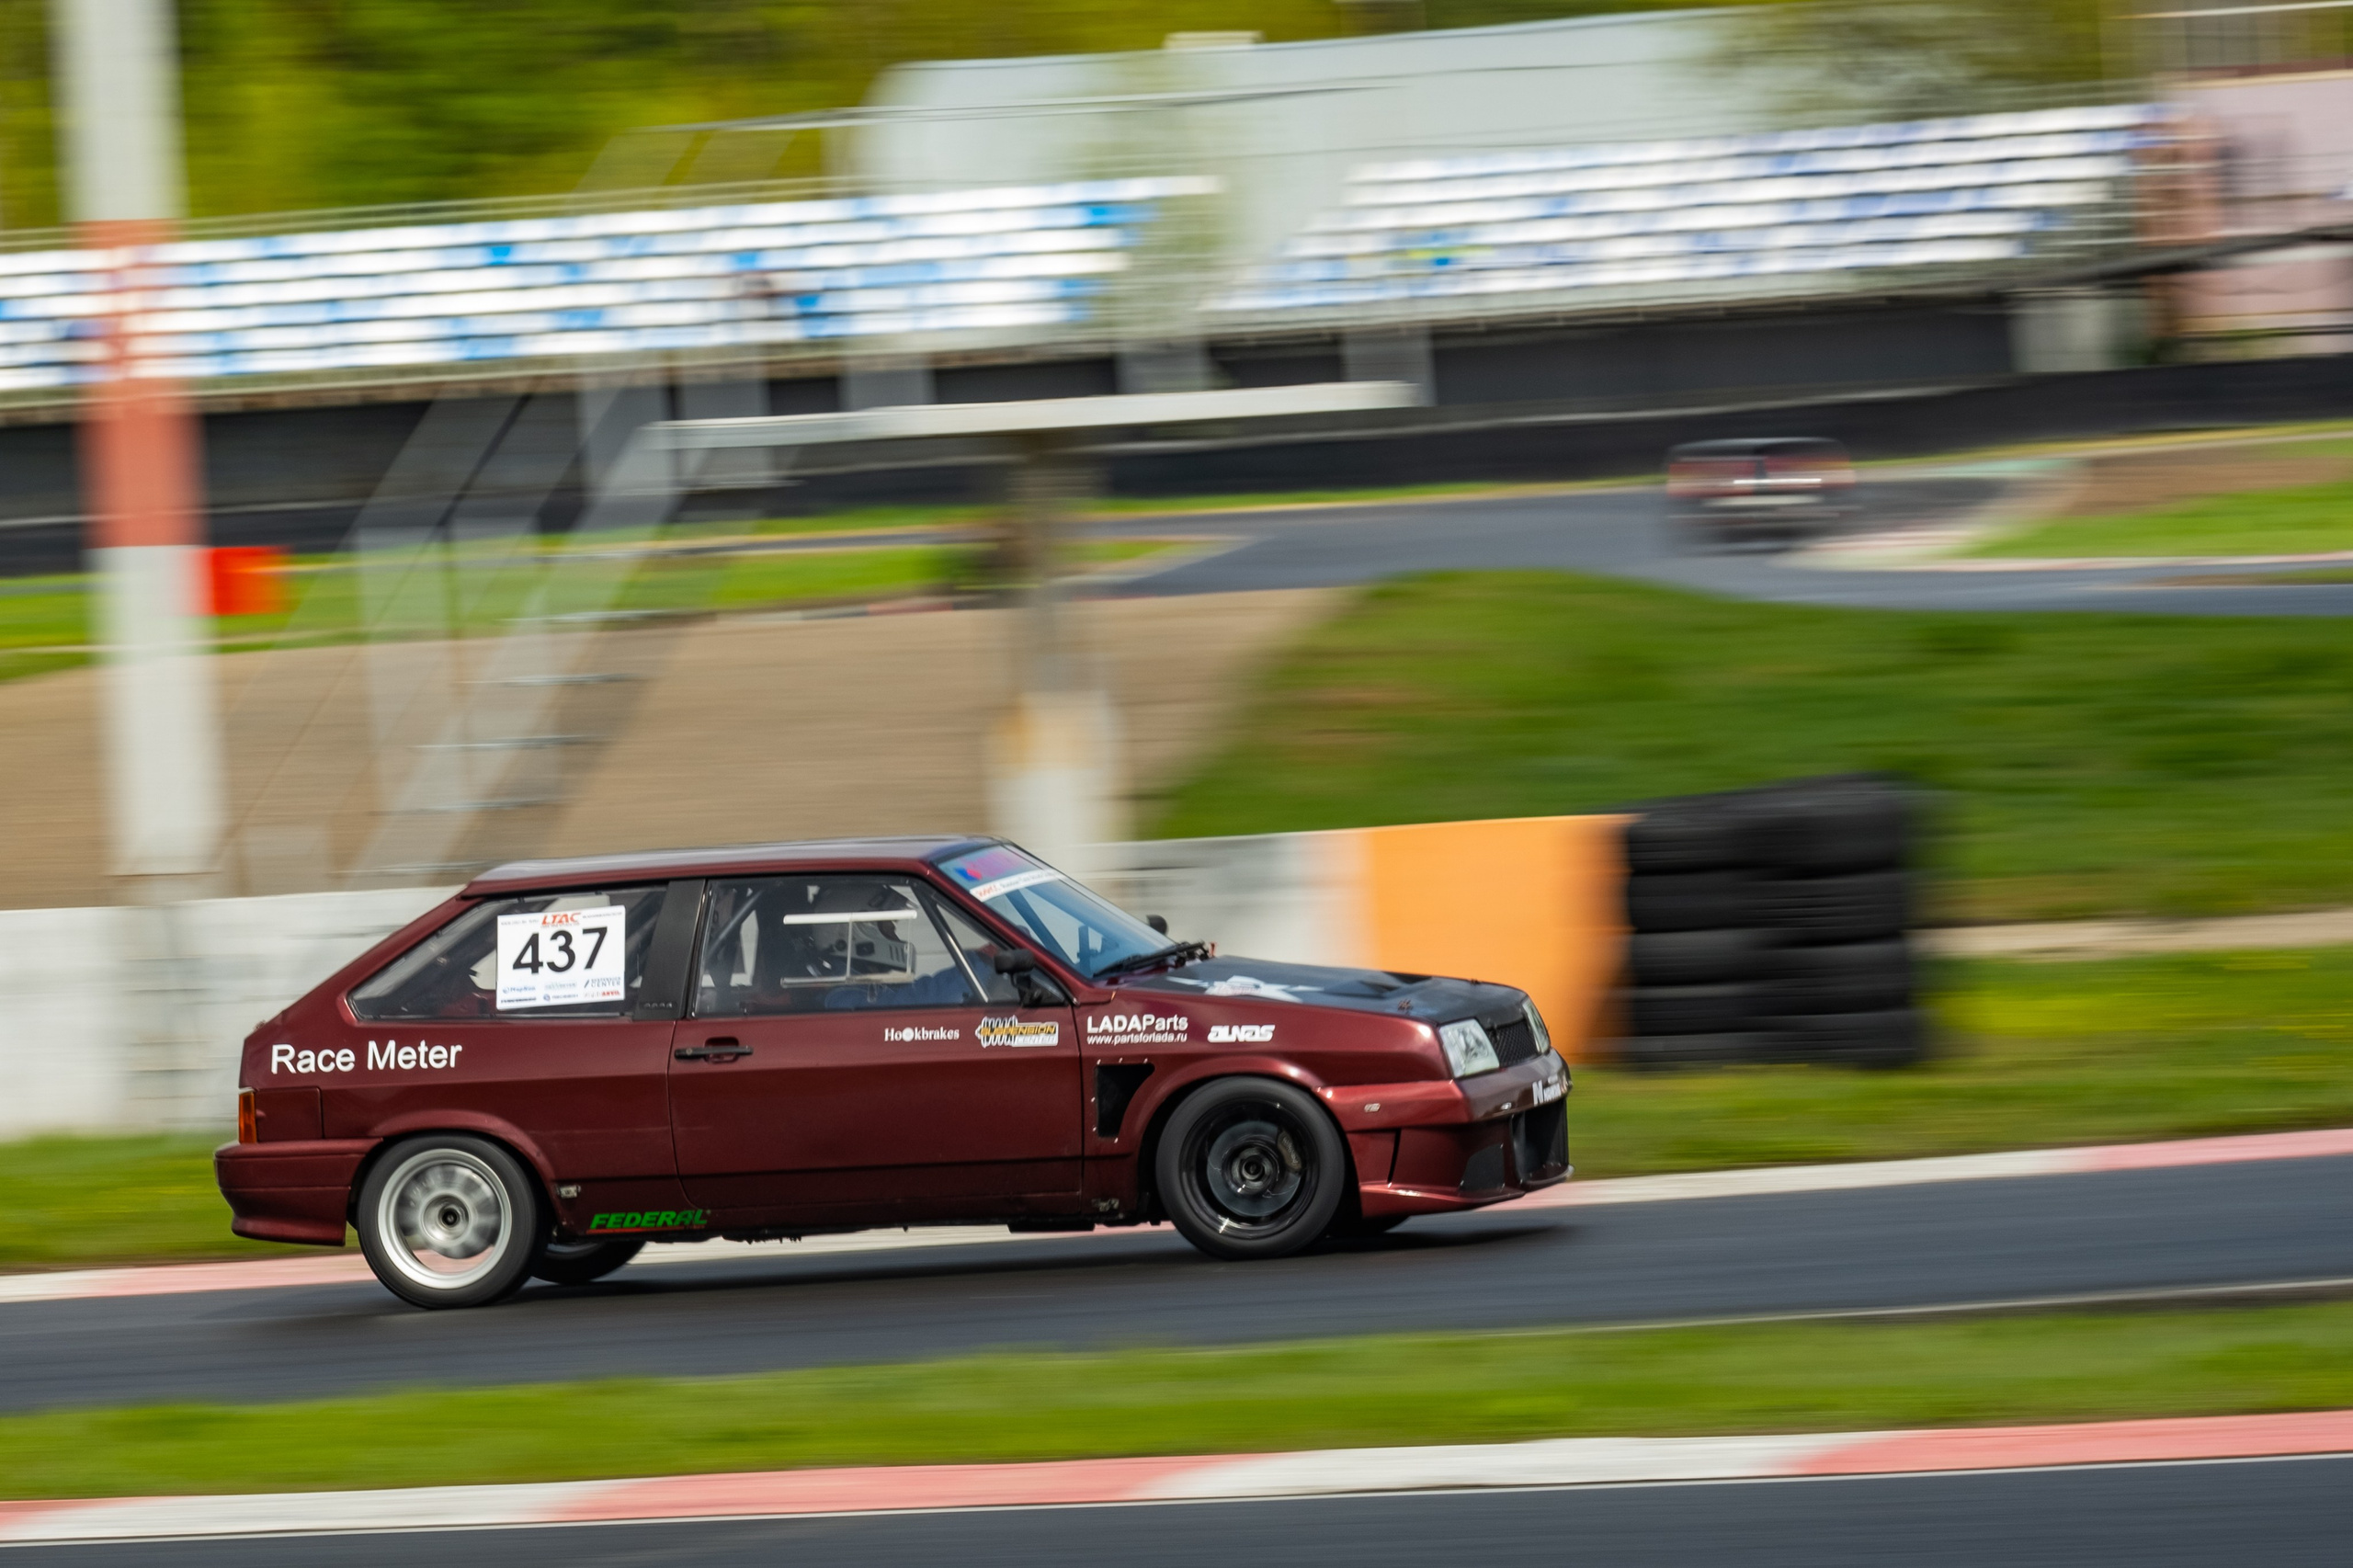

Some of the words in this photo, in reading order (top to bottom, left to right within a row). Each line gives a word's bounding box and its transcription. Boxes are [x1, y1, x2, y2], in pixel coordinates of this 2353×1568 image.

[541, 912, 582, 926] LTAC
[512, 926, 608, 975] 437
[980, 1024, 1056, 1036] SUSPENSION
[1086, 1014, 1188, 1034] LADAParts
[1086, 1031, 1188, 1046] www.partsforlada.ru
[270, 1043, 356, 1074] Race
[367, 1040, 463, 1071] Meter
[589, 1209, 708, 1230] FEDERAL
